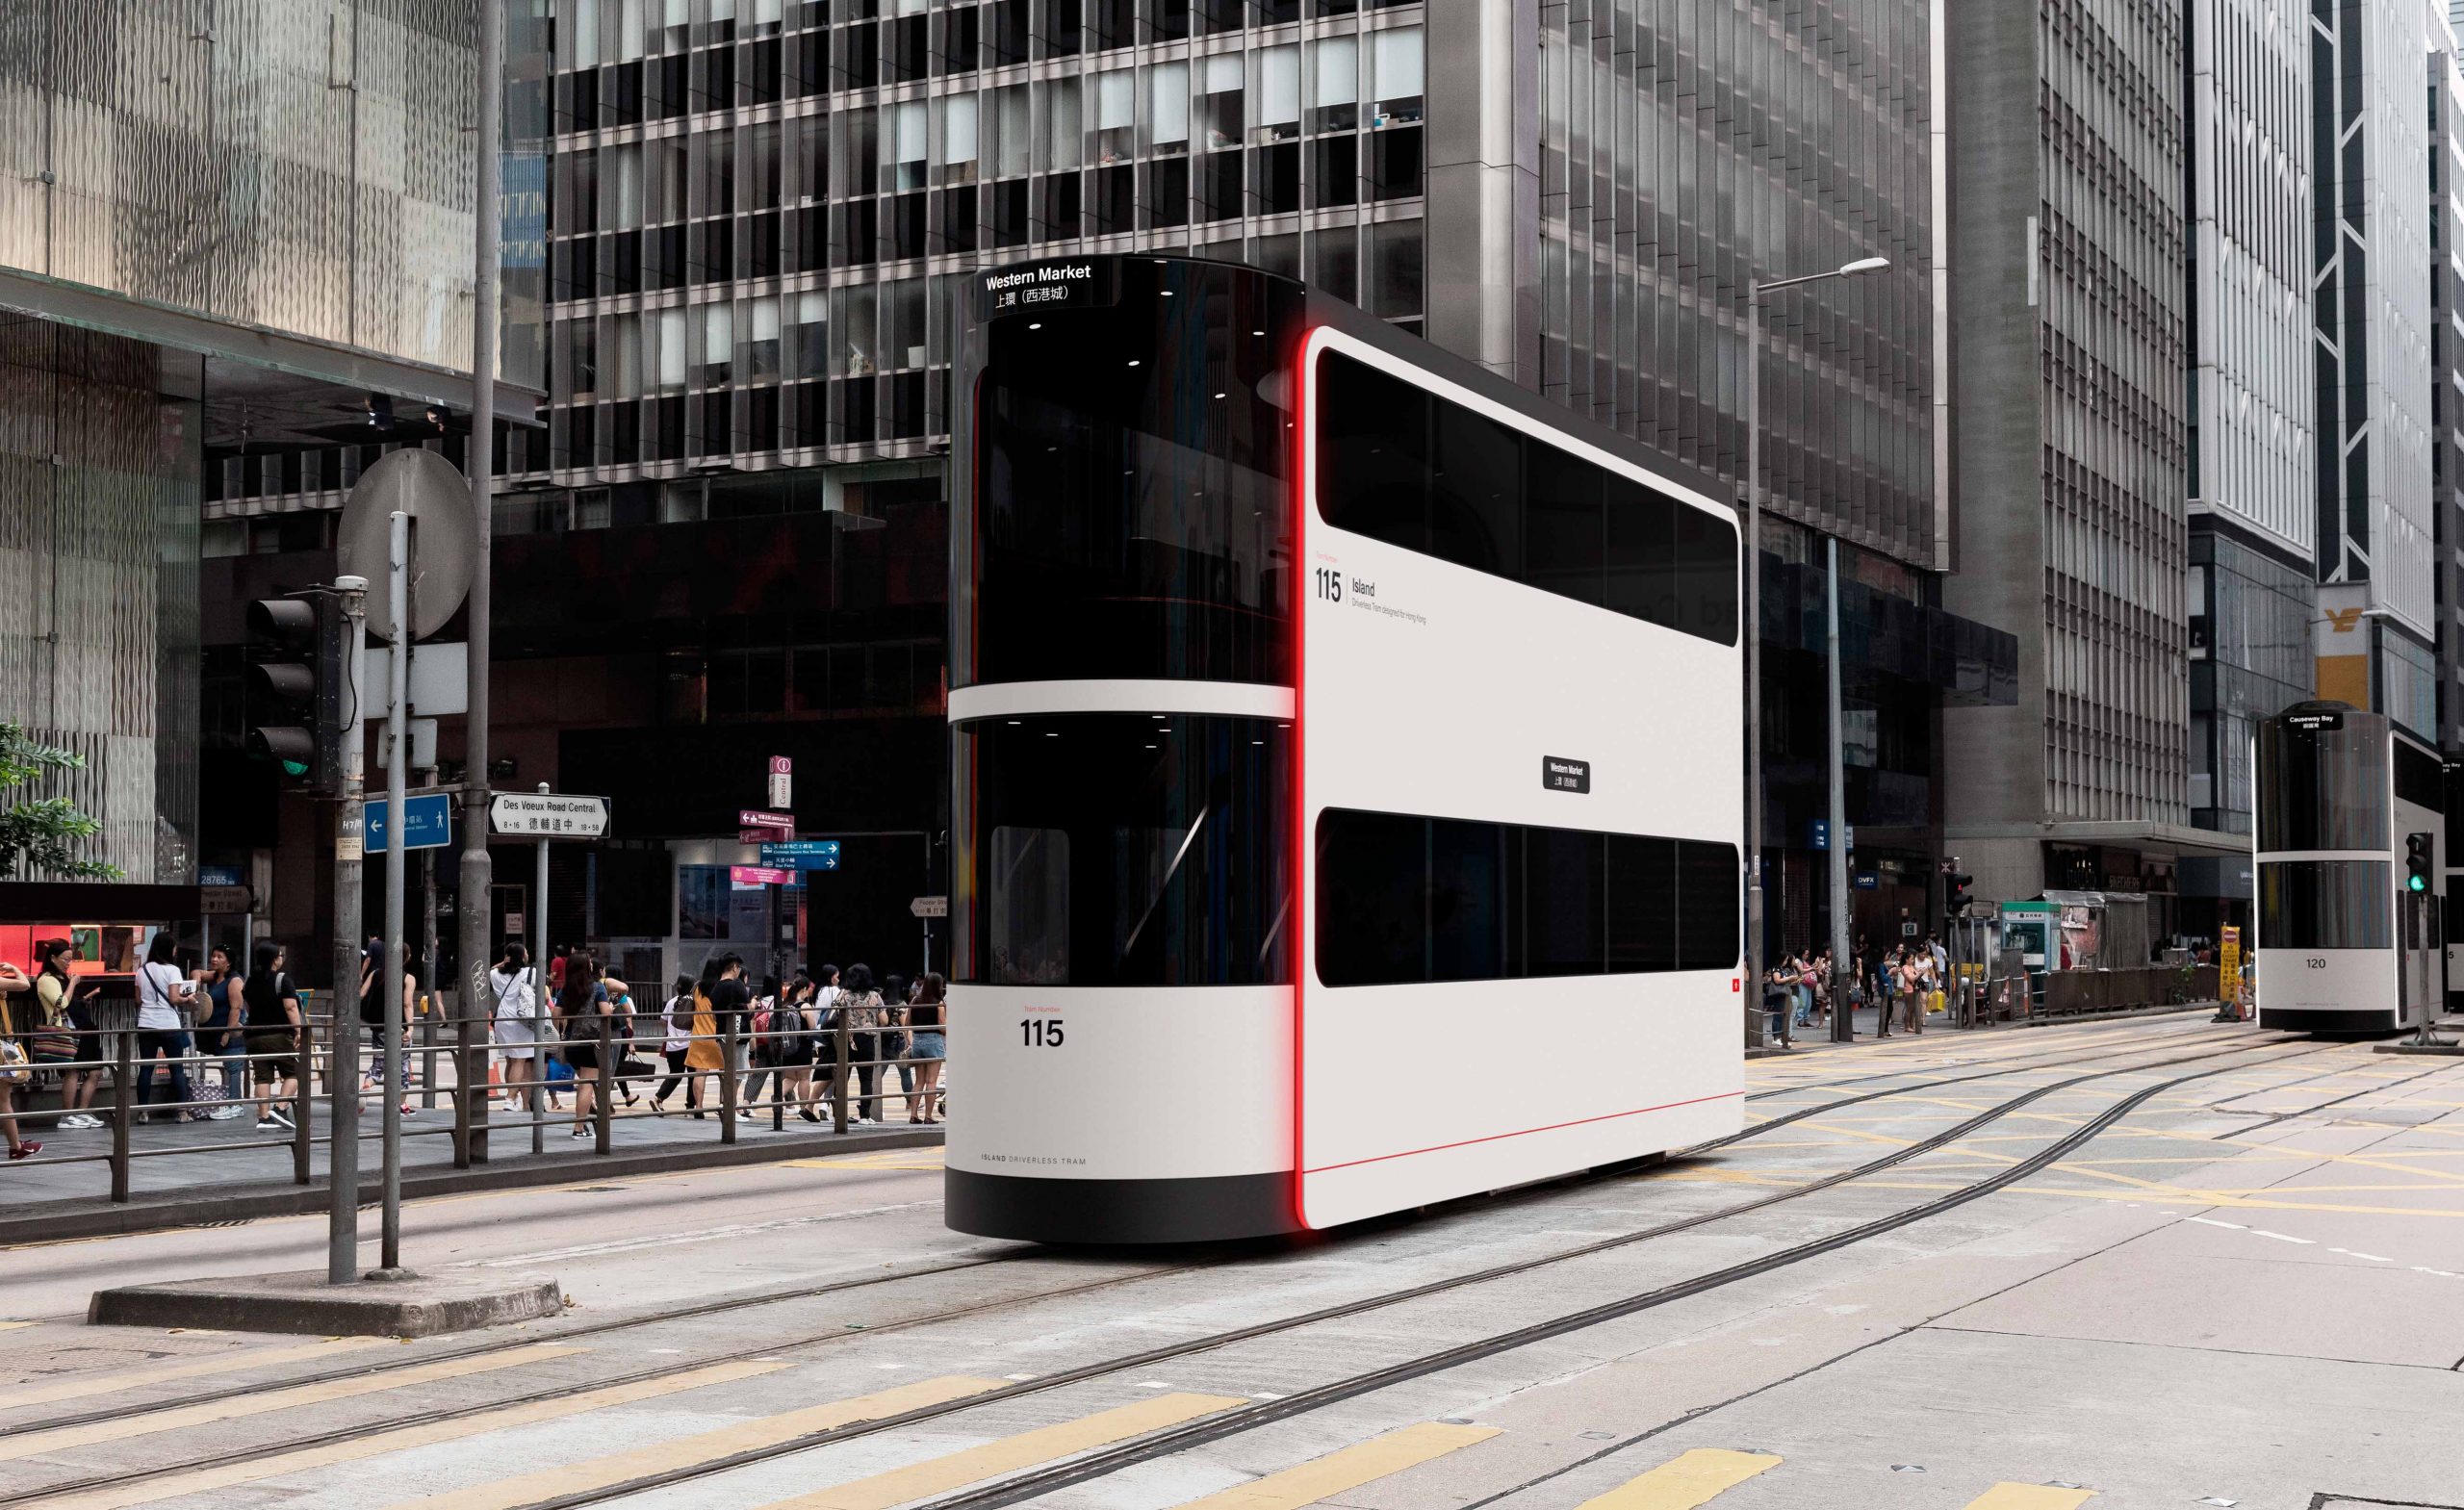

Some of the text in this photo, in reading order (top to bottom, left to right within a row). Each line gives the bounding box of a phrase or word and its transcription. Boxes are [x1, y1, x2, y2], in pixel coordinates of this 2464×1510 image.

[987, 265, 1091, 291] Western Market
[1316, 567, 1342, 602] 115
[1352, 577, 1375, 597] Island
[1550, 761, 1583, 776] Western Market
[503, 800, 596, 813] Des Voeux Road Central
[528, 817, 573, 832] 德輔道中
[2306, 959, 2326, 969] 120
[1020, 1019, 1065, 1047] 115
[981, 1154, 1007, 1163] ISLAND
[1008, 1156, 1058, 1164] DRIVERLESS
